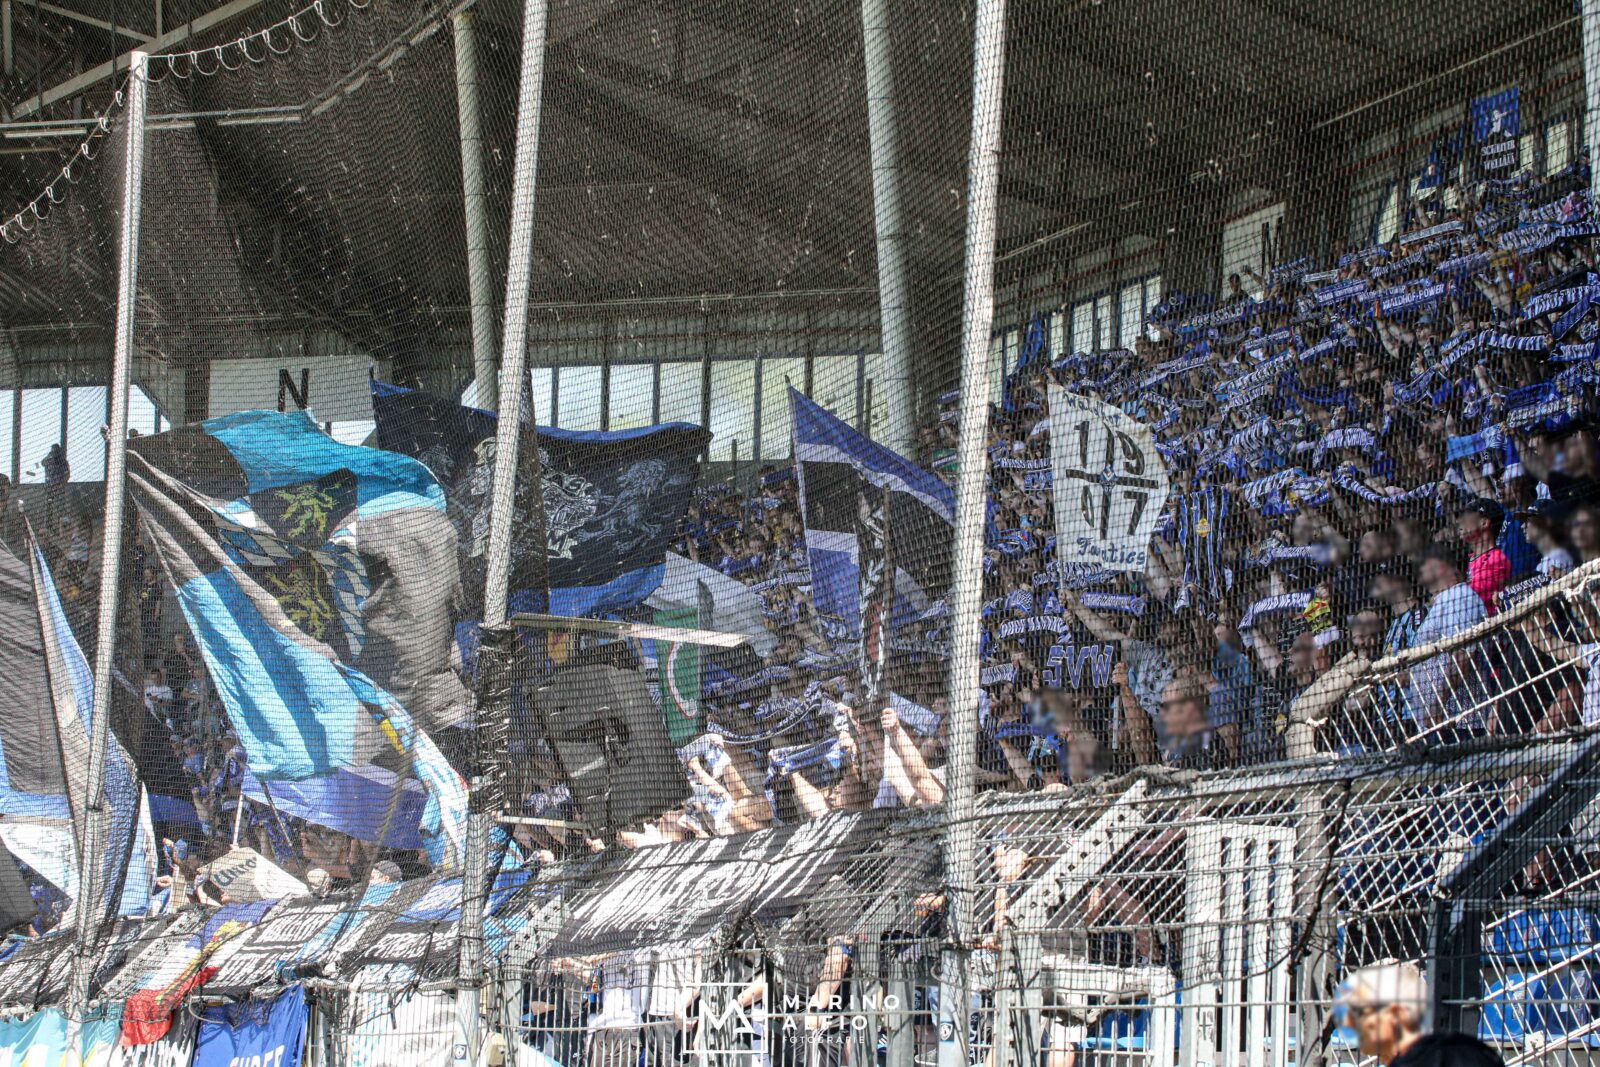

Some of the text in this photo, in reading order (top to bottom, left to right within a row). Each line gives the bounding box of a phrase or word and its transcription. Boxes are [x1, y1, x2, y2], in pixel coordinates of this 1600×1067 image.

[1383, 283, 1445, 310] WALDHOF-POWER
[278, 368, 309, 412] N
[1042, 645, 1114, 690] SVW
